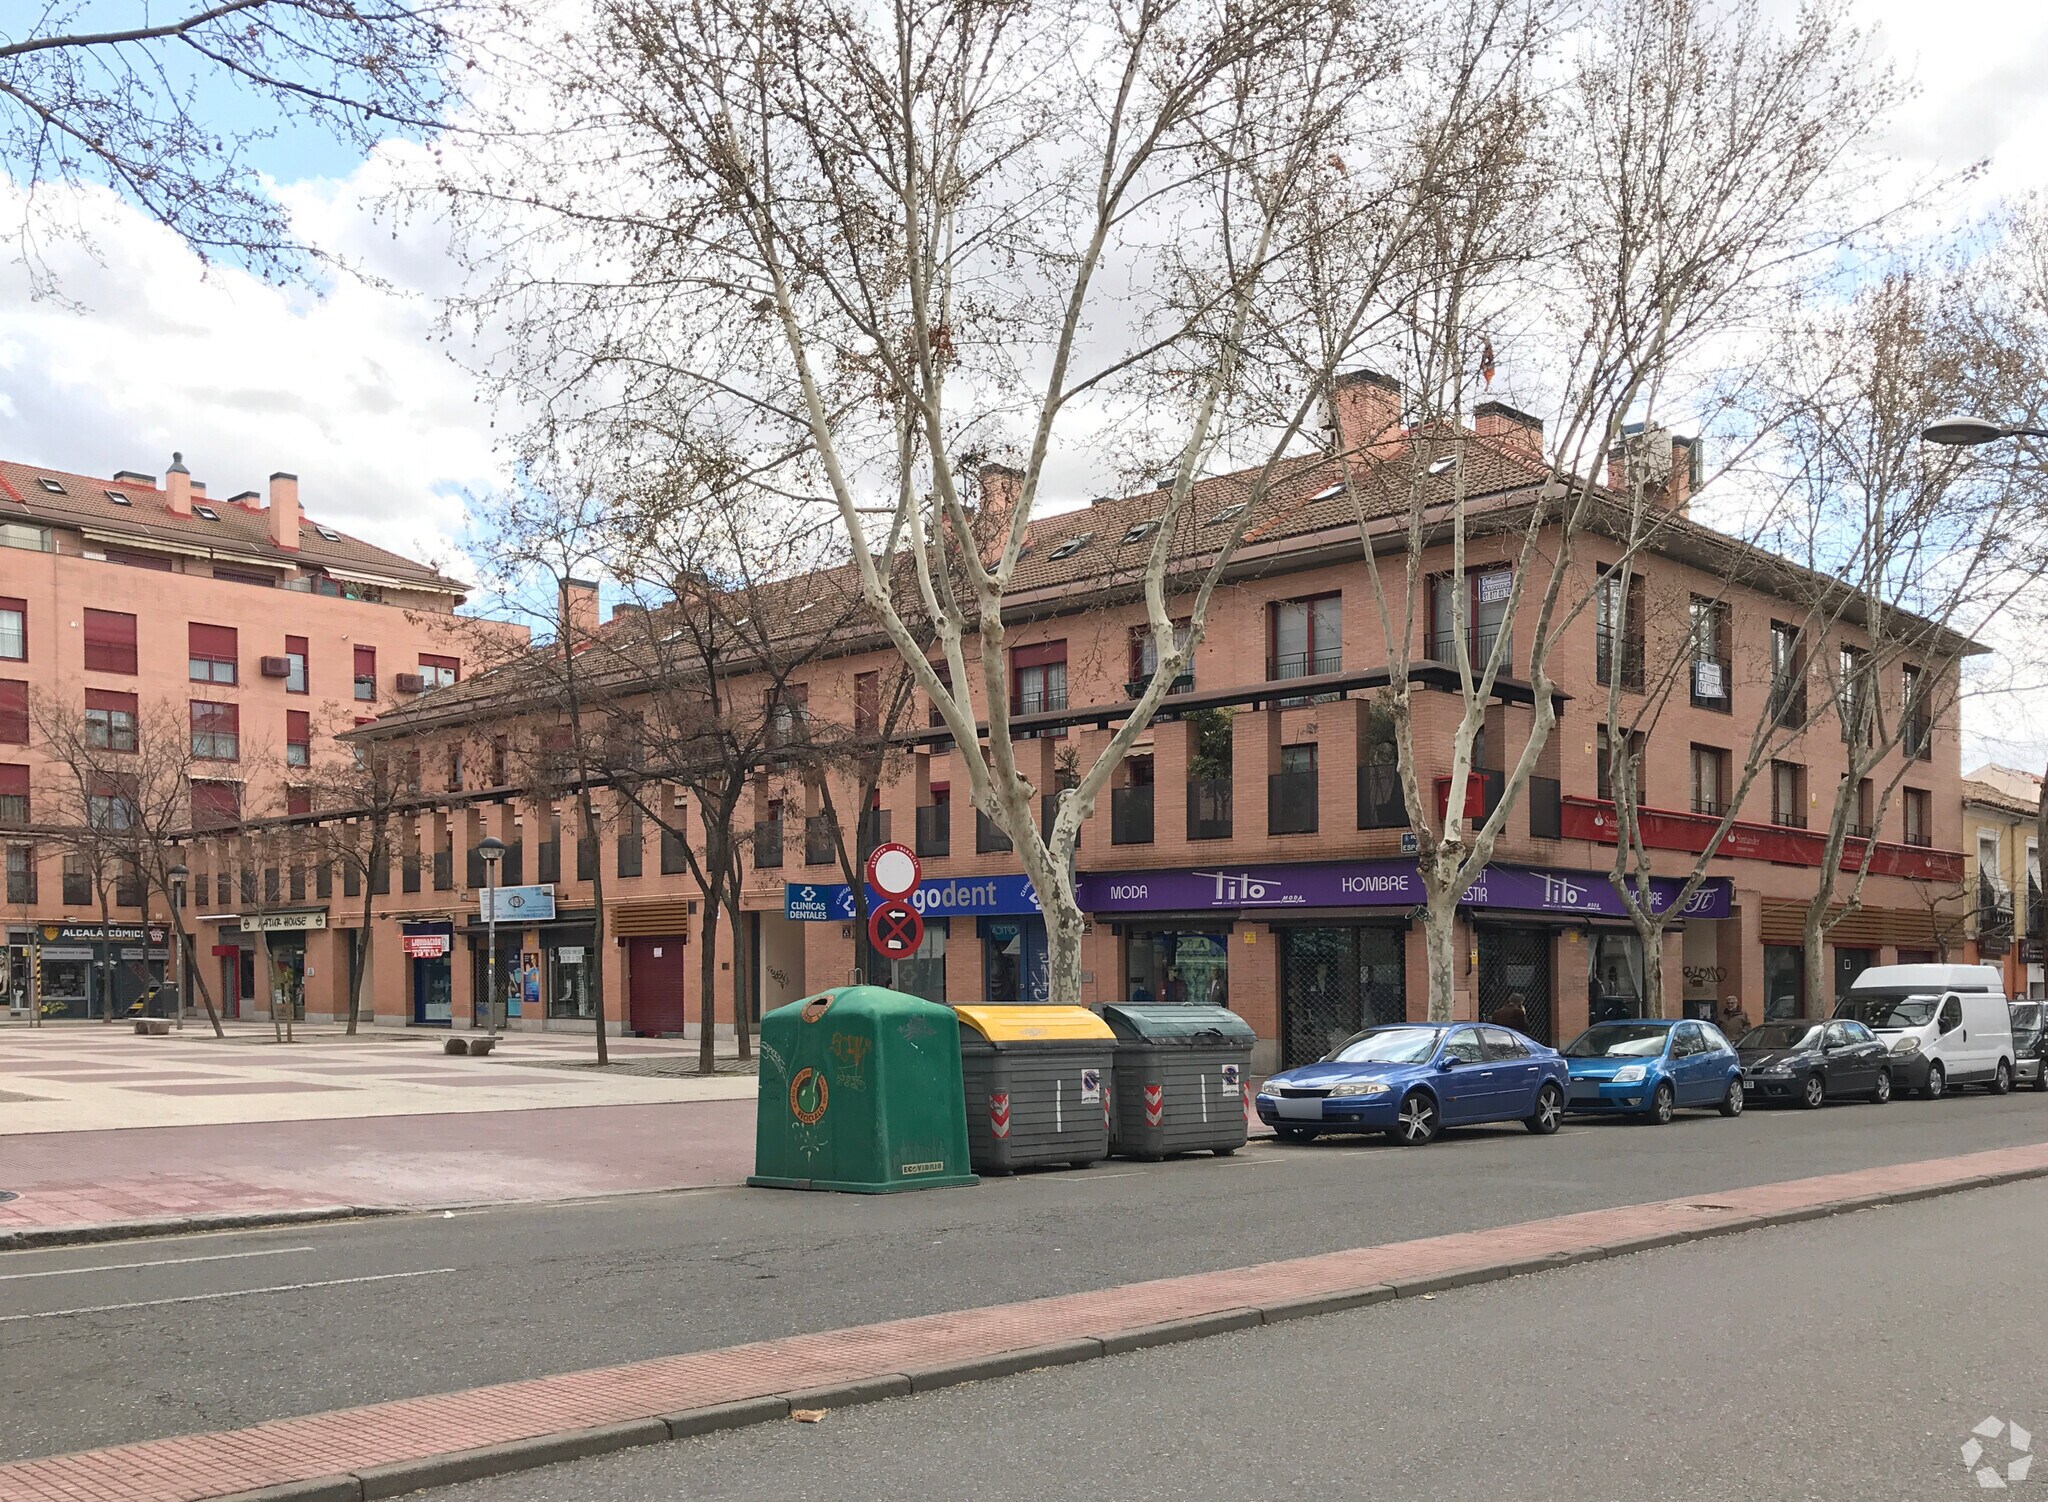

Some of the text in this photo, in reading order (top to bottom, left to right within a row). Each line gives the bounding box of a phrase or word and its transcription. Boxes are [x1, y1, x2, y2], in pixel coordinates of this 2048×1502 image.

[871, 847, 887, 868] EXCEPTO
[1342, 876, 1409, 892] HOMBRE
[1110, 885, 1148, 899] MODA
[1461, 886, 1488, 902] ESTIR
[1629, 890, 1663, 905] HOBRE
[791, 901, 826, 911] CLINICAS
[789, 911, 827, 919] DENTALES
[283, 916, 307, 927] HOUSE
[62, 926, 104, 937] ALCALÁ
[411, 948, 443, 957] TOTAL
